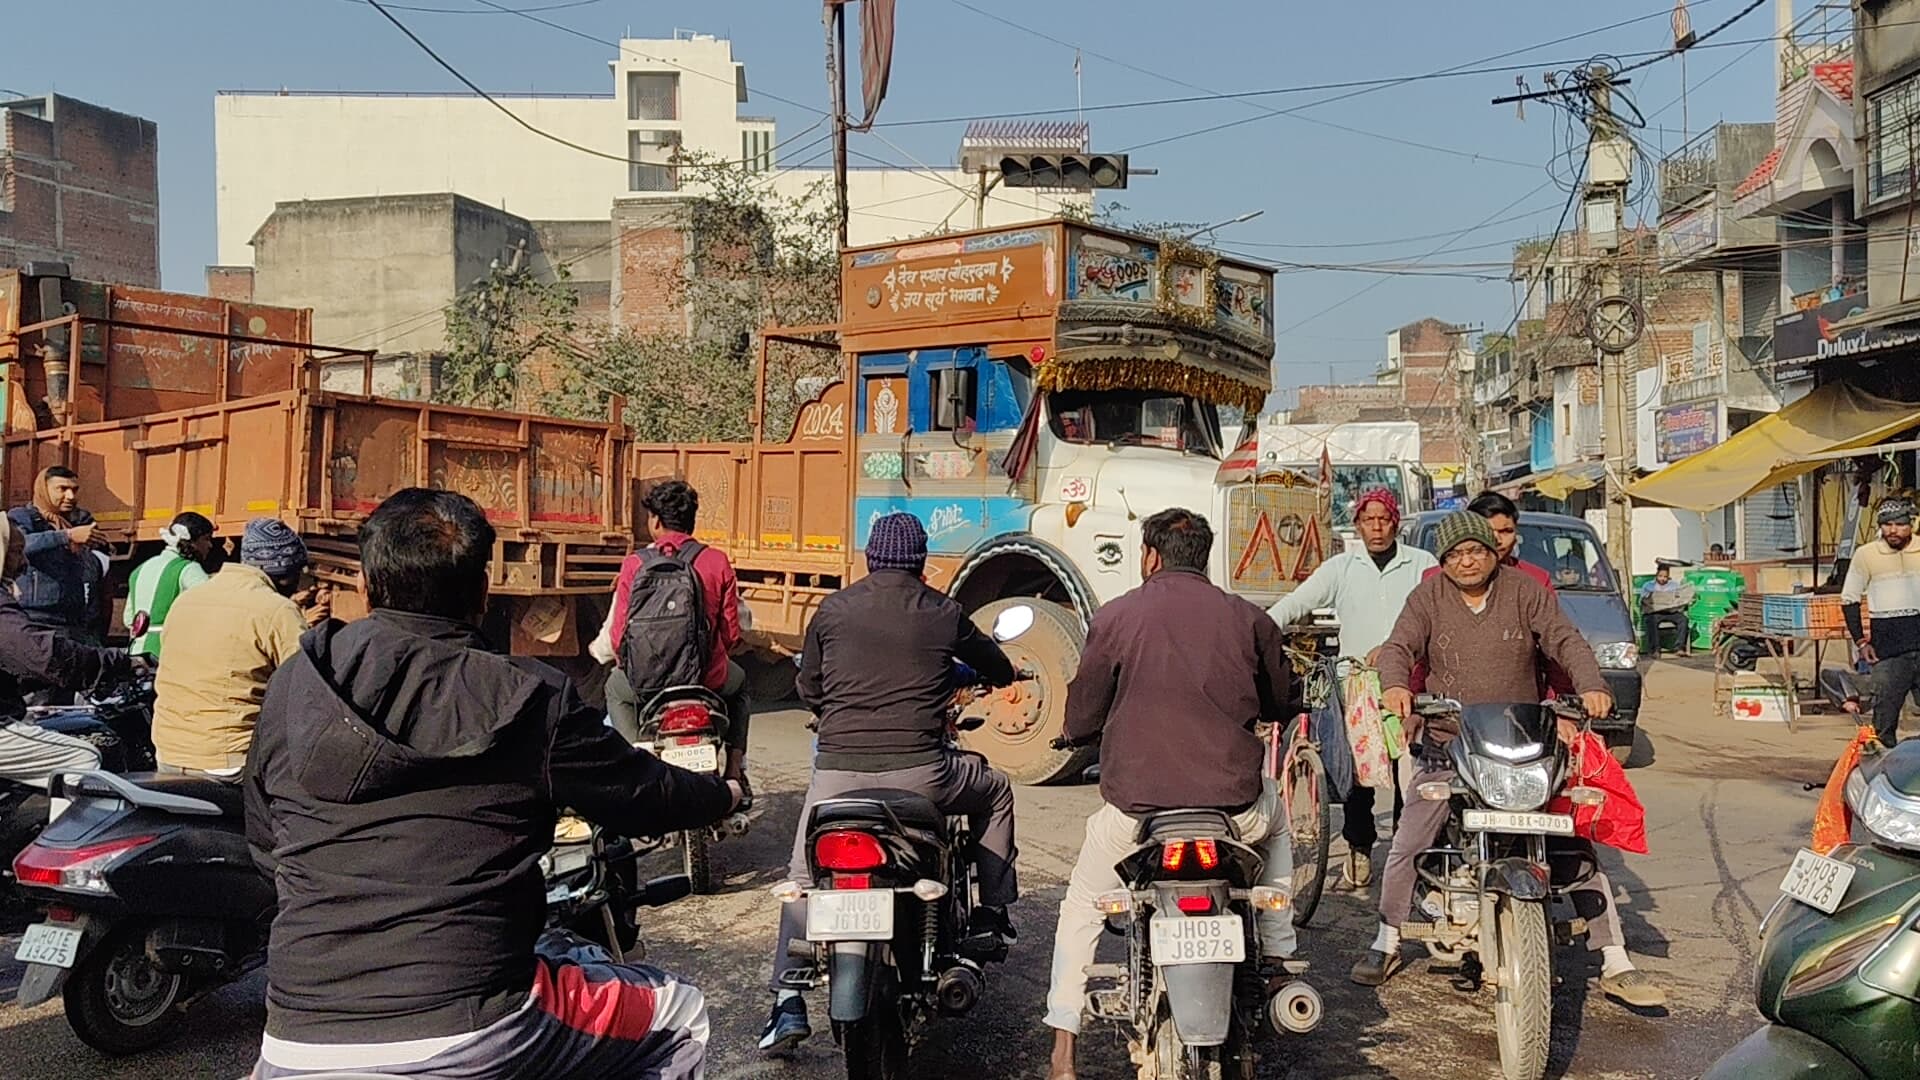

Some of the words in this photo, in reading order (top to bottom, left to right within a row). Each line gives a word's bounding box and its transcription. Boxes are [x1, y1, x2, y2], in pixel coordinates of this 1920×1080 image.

[901, 291, 923, 309] जय
[925, 286, 948, 312] सूर्य
[802, 402, 844, 435] 2024
[1804, 857, 1840, 884] JH08
[836, 894, 878, 913] JH08
[1172, 920, 1221, 939] JH08
[1171, 939, 1234, 960] J8878
